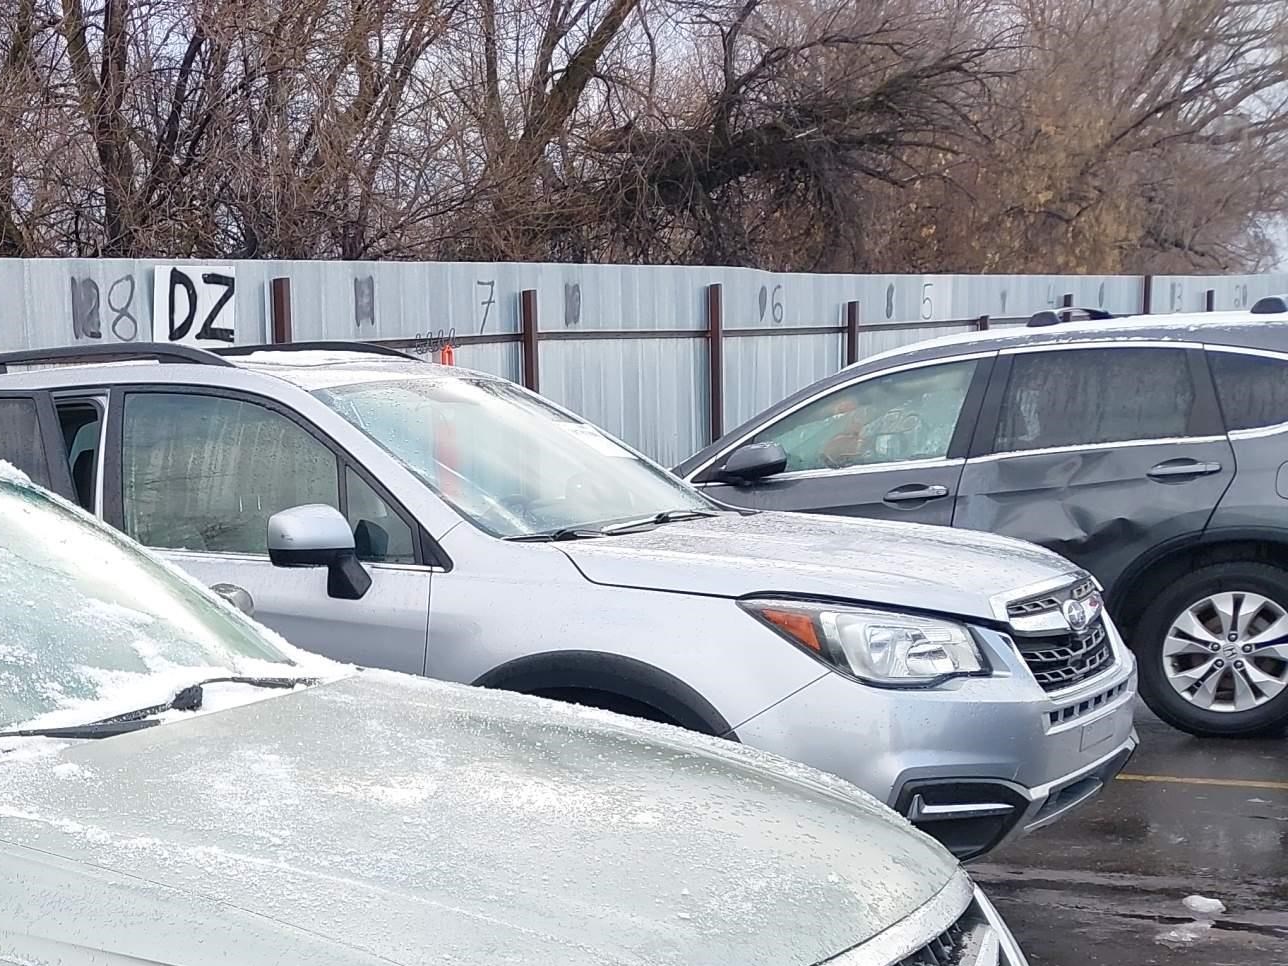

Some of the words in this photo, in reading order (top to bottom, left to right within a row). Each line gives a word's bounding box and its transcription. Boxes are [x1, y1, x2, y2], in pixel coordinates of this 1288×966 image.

[168, 266, 235, 343] DZ
[476, 279, 496, 335] 7
[771, 284, 784, 324] 6
[922, 283, 934, 320] 5
